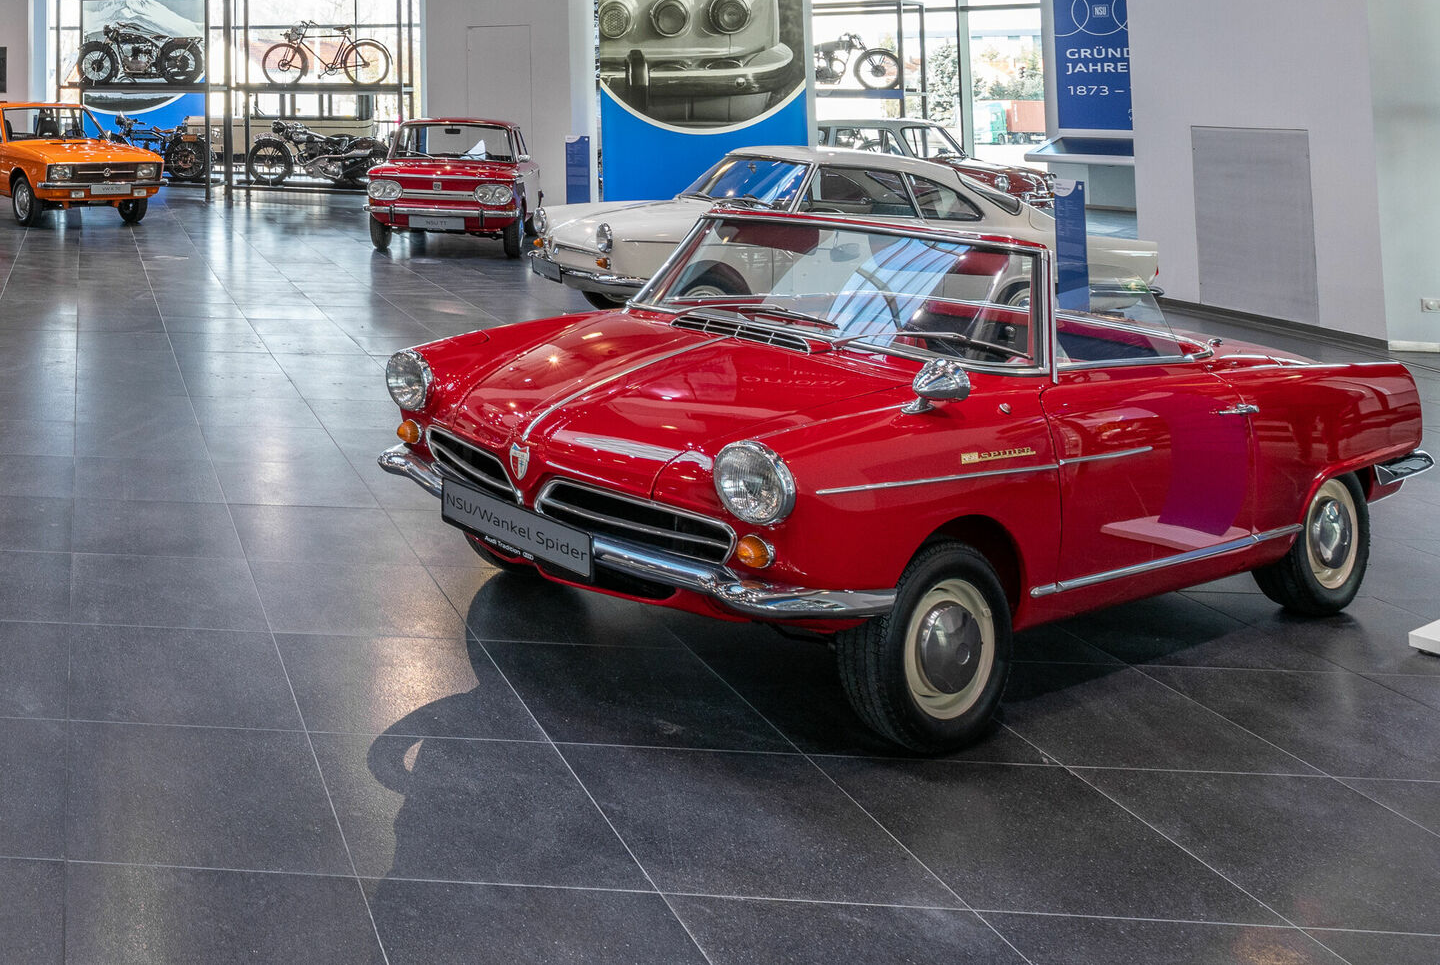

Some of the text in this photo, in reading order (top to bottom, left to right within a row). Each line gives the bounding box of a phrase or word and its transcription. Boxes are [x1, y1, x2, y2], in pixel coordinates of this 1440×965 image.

[1094, 6, 1107, 16] NSU
[1066, 62, 1129, 75] JAHRE
[1067, 85, 1110, 96] 1873
[980, 446, 1032, 459] SPIDER
[446, 492, 588, 563] NSU/Wankel Spider
[484, 535, 521, 555] Audi Tradition
